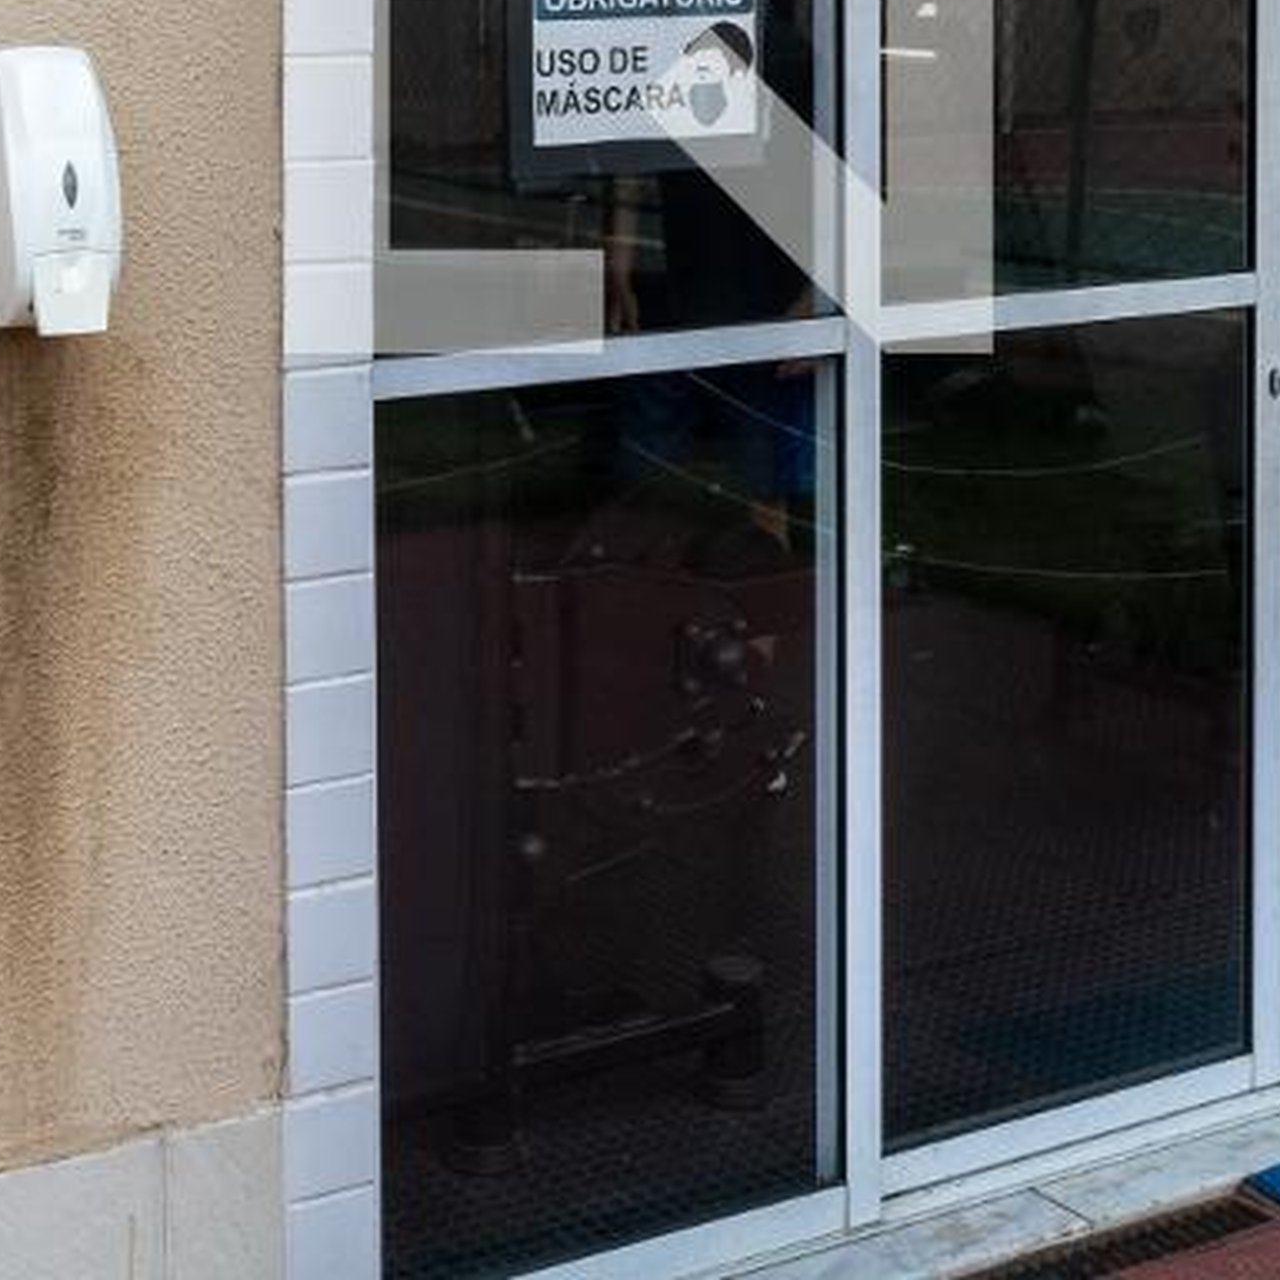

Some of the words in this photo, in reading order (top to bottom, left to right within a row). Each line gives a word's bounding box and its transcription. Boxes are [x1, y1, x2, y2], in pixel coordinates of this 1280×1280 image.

[536, 49, 601, 77] USO
[609, 46, 649, 74] DE
[536, 80, 686, 117] MÁSCARA
